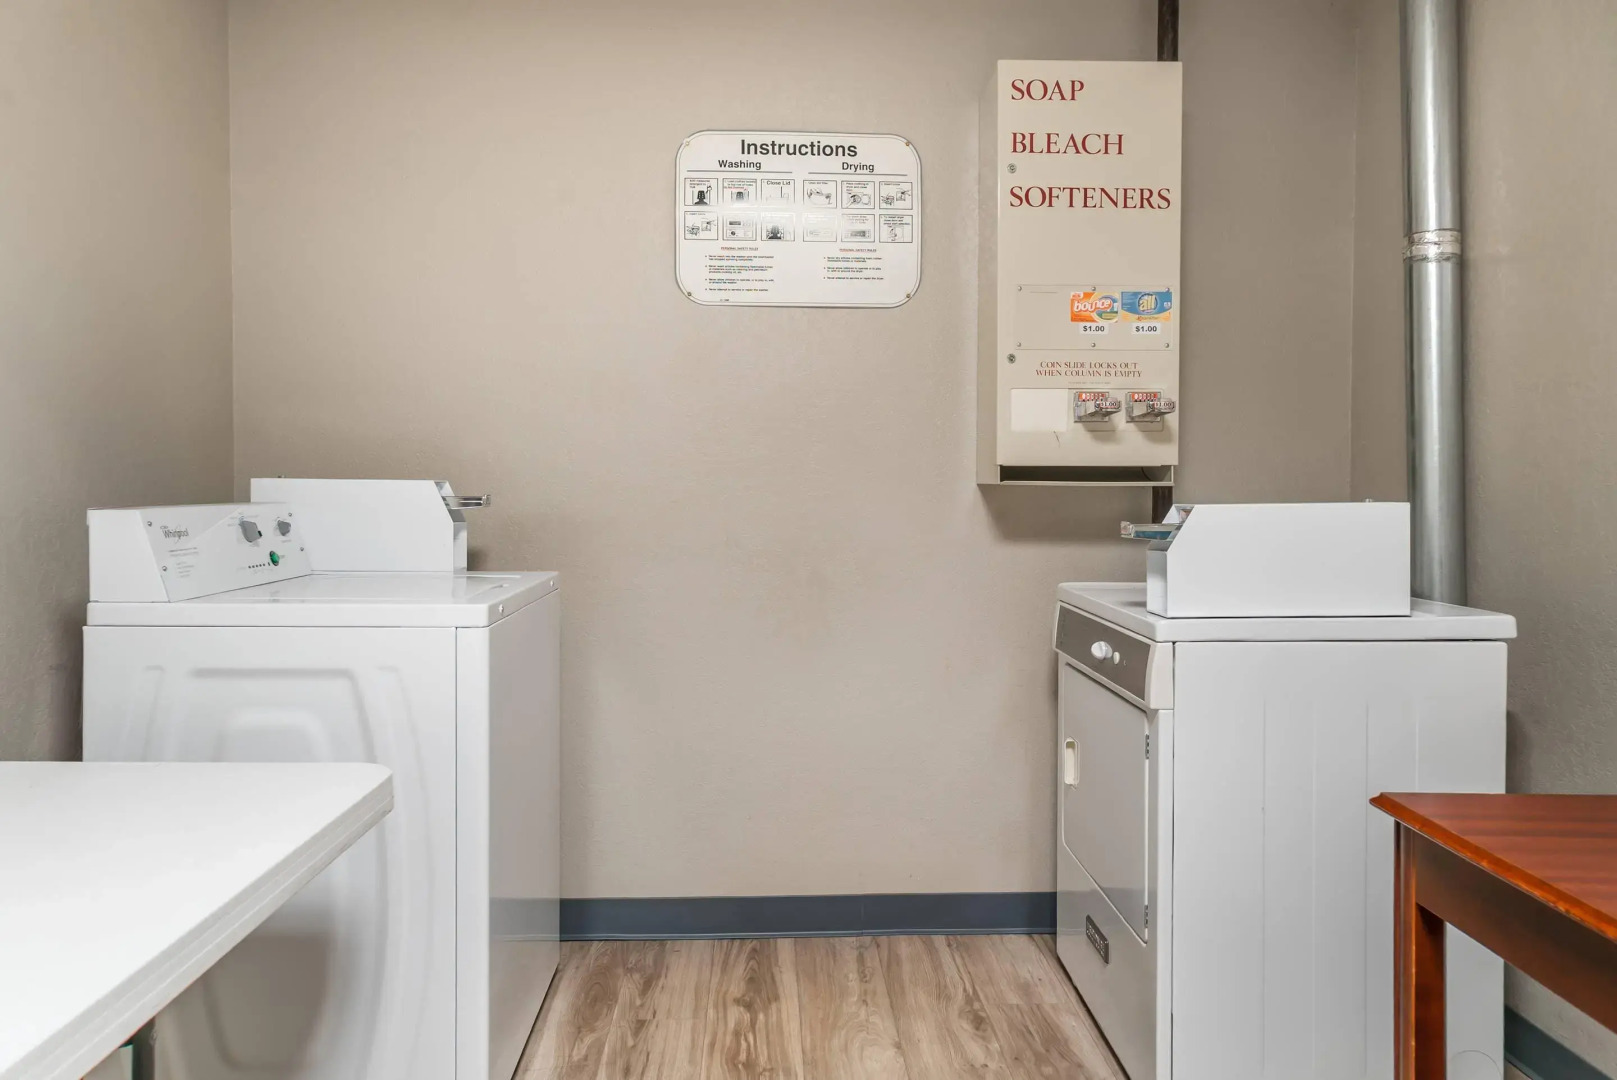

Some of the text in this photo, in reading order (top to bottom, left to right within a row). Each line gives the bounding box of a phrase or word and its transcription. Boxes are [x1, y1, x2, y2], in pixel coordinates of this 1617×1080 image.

[1011, 79, 1085, 101] SOAP
[741, 139, 858, 157] Instructions
[1011, 132, 1124, 155] BLEACH
[718, 160, 762, 170] Washing
[842, 162, 875, 173] Drying
[1009, 186, 1171, 210] SOFTENERS
[1073, 299, 1112, 312] bounce
[1139, 294, 1156, 311] all
[1040, 361, 1062, 369] COIN
[1119, 362, 1138, 370] OUT
[1036, 369, 1062, 377] WHEN
[1114, 370, 1142, 378] EMPTY
[162, 528, 189, 539] Whirlpool
